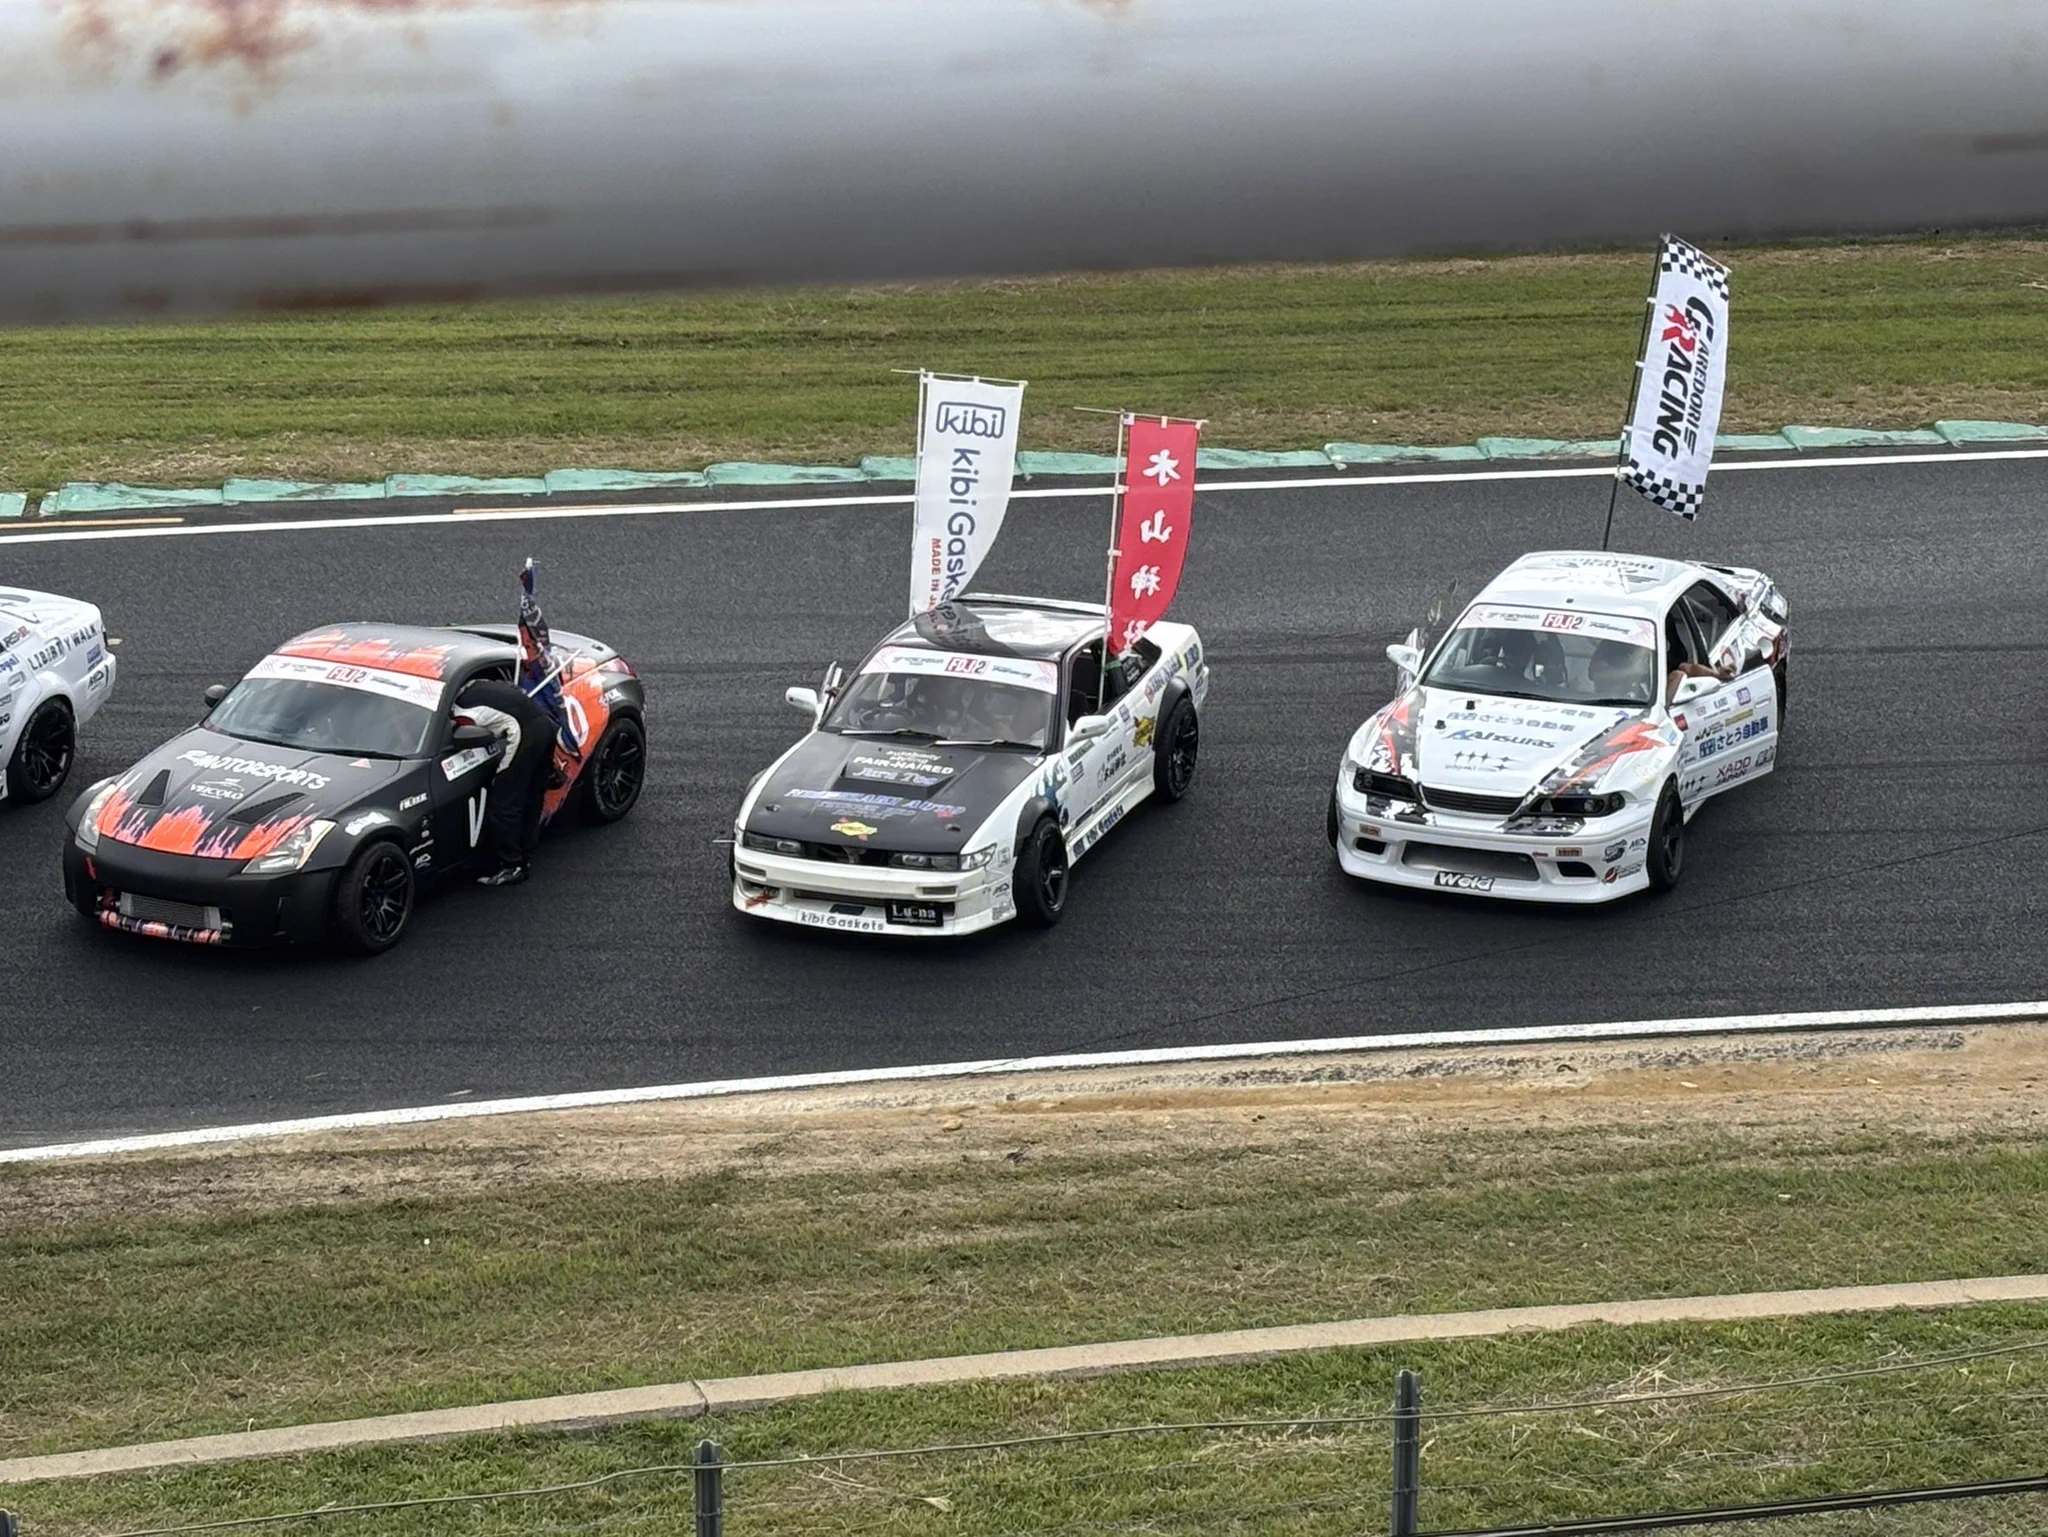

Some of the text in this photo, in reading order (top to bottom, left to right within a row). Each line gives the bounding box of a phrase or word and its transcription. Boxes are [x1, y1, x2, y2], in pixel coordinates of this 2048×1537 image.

[1653, 303, 1696, 460] RACING
[940, 405, 1004, 439] kibi
[949, 448, 981, 506] kibi
[931, 538, 942, 575] MADE
[932, 579, 941, 592] IN
[73, 624, 98, 646] WALK
[827, 915, 884, 931] Gaskets
